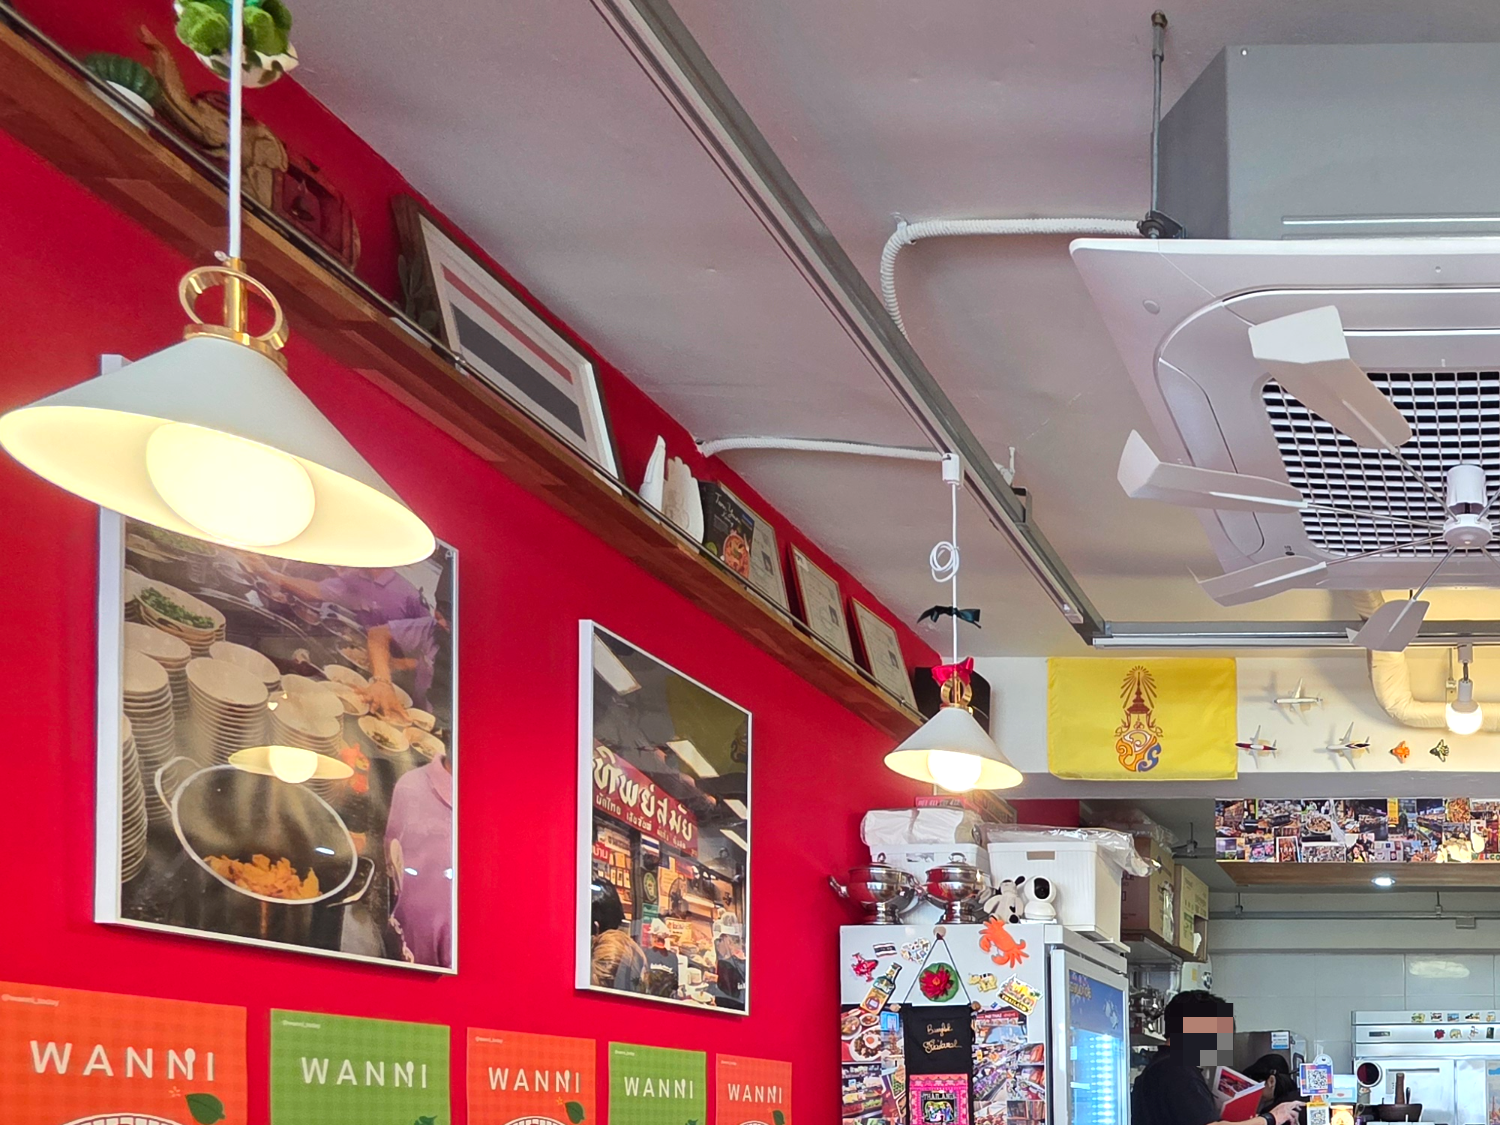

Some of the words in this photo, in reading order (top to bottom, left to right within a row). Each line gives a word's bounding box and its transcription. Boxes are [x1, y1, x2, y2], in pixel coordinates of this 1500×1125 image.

[29, 1039, 214, 1082] WANNI
[301, 1056, 427, 1089] WANNI
[488, 1066, 581, 1094] WANNI
[623, 1076, 693, 1100] WANNI
[727, 1083, 783, 1104] WANNI
